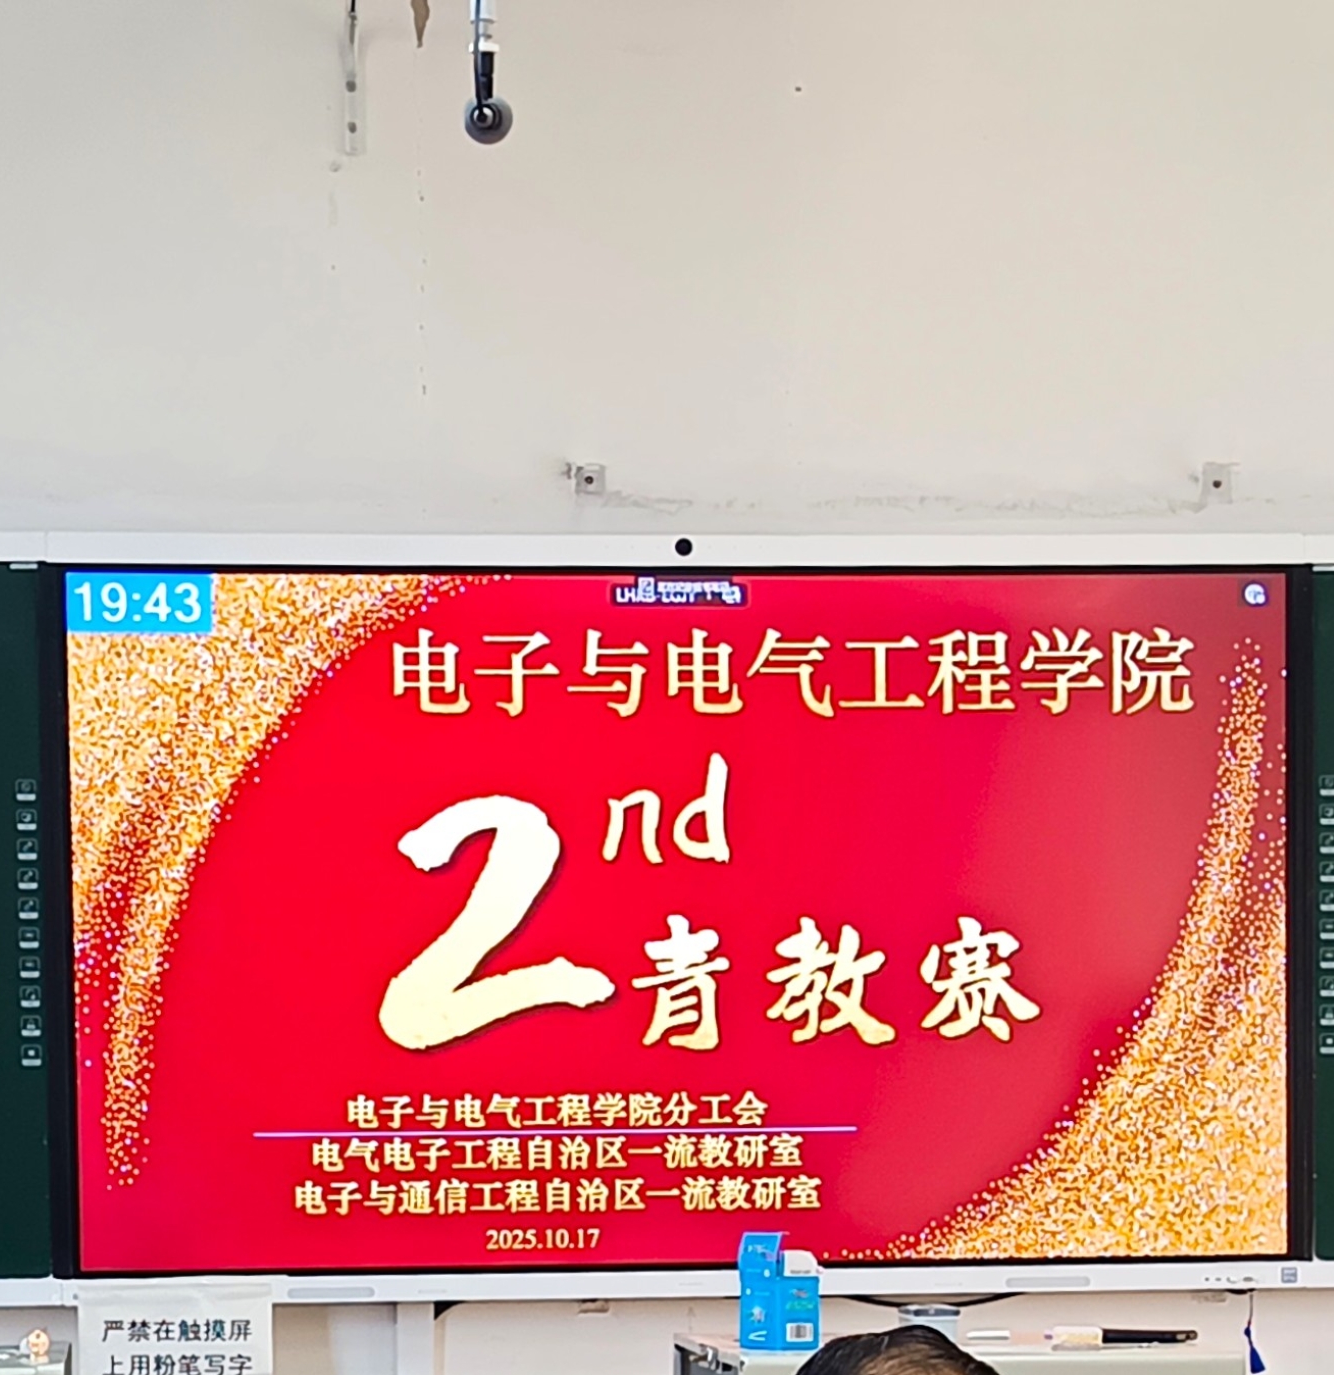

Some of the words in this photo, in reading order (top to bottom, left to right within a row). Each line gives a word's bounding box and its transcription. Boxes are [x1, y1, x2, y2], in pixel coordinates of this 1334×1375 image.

[74, 581, 202, 624] 19:43
[390, 626, 1196, 718] 电子与电气工程学院
[630, 914, 1042, 1050] 青教赛
[346, 1090, 769, 1129] 电子与电气工程学院分工会
[310, 1134, 805, 1173] 电气电子工程自治区一流教研室
[293, 1175, 823, 1216] 电子与通信工程自治区一流教研室
[485, 1228, 601, 1250] 2025.10.17
[101, 1319, 253, 1343] 严禁在触摸屏
